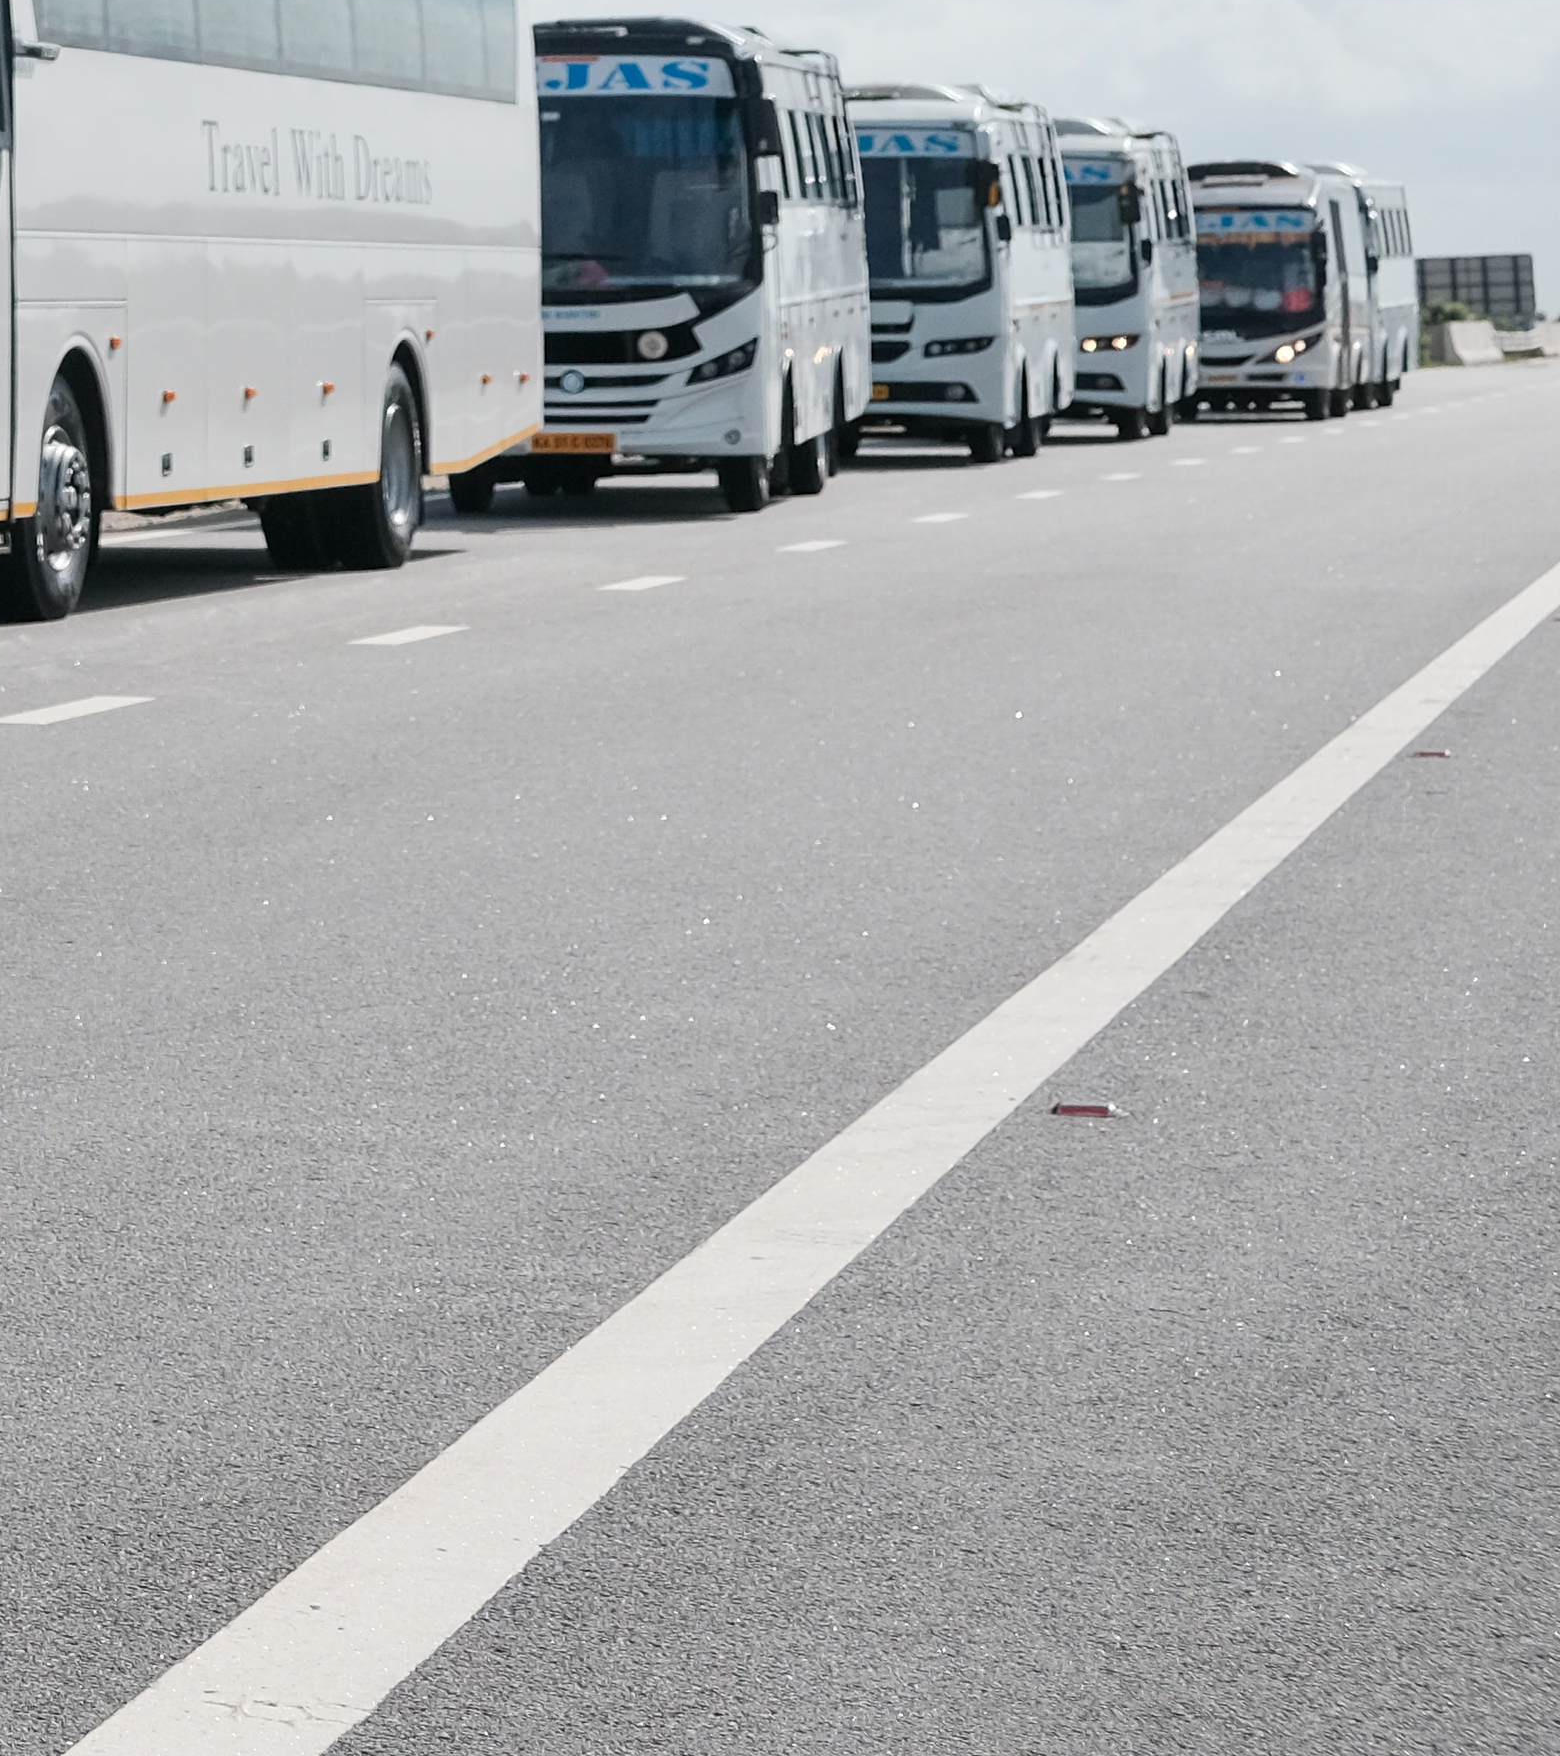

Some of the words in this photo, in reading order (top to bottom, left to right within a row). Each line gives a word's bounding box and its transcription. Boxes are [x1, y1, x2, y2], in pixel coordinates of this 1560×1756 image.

[544, 62, 710, 90] JAS
[201, 120, 280, 196] Travel
[291, 128, 345, 201] With
[353, 134, 432, 205] Dreams
